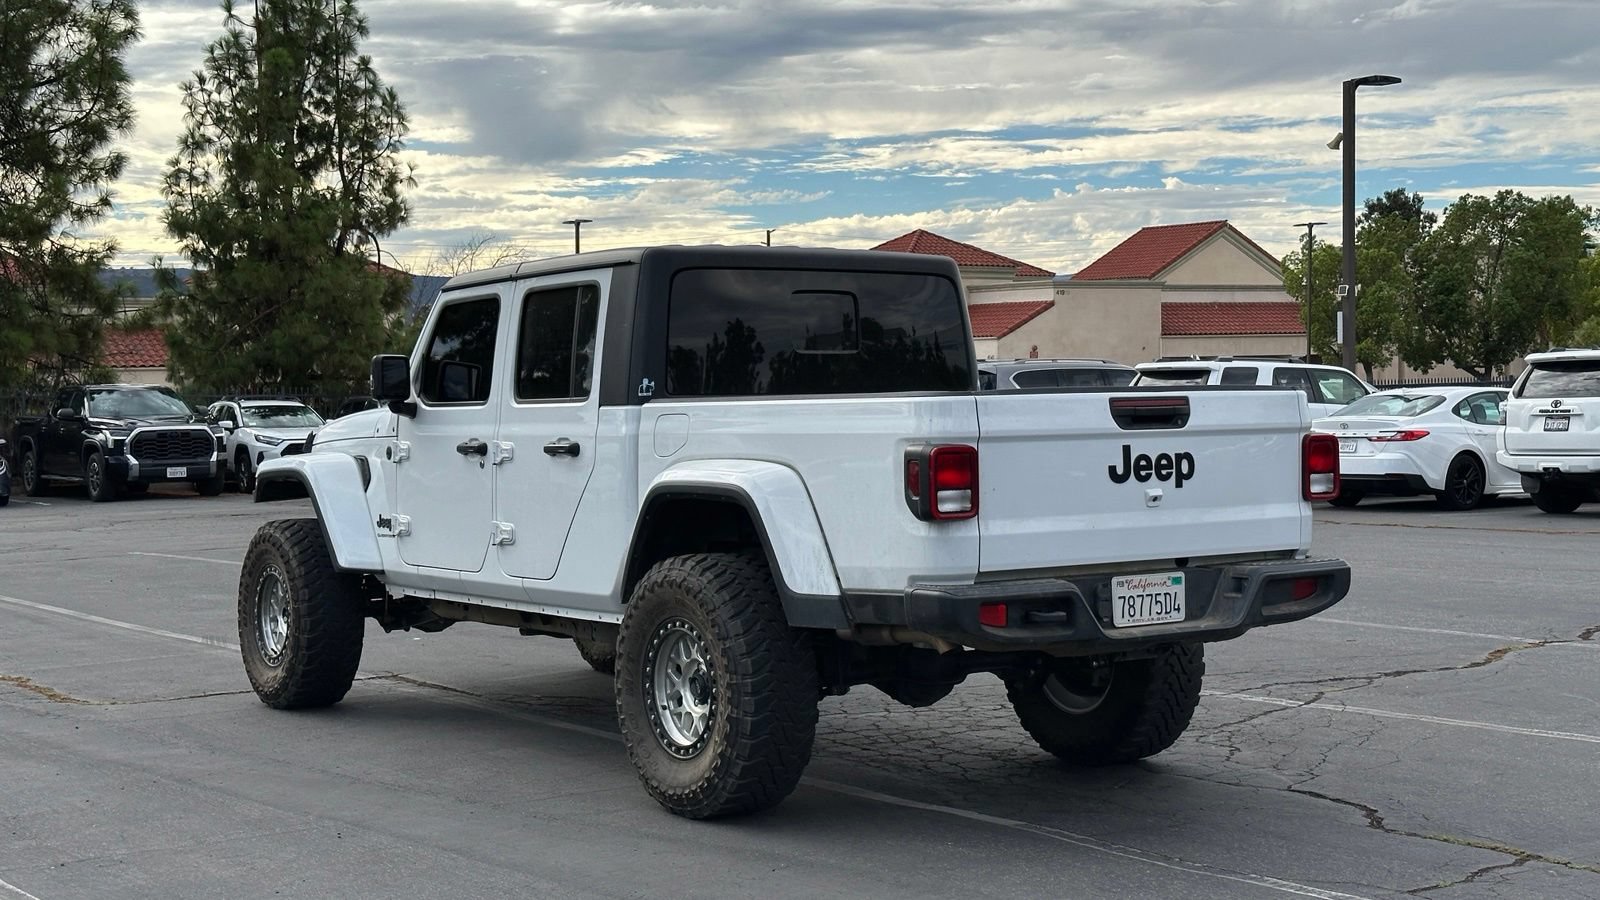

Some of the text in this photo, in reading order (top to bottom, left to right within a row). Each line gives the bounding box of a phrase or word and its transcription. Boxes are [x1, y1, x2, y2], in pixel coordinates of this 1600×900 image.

[1108, 444, 1195, 488] Jeep
[377, 513, 391, 531] Jeep
[1125, 578, 1170, 592] California
[1118, 592, 1181, 619] 78775D4
